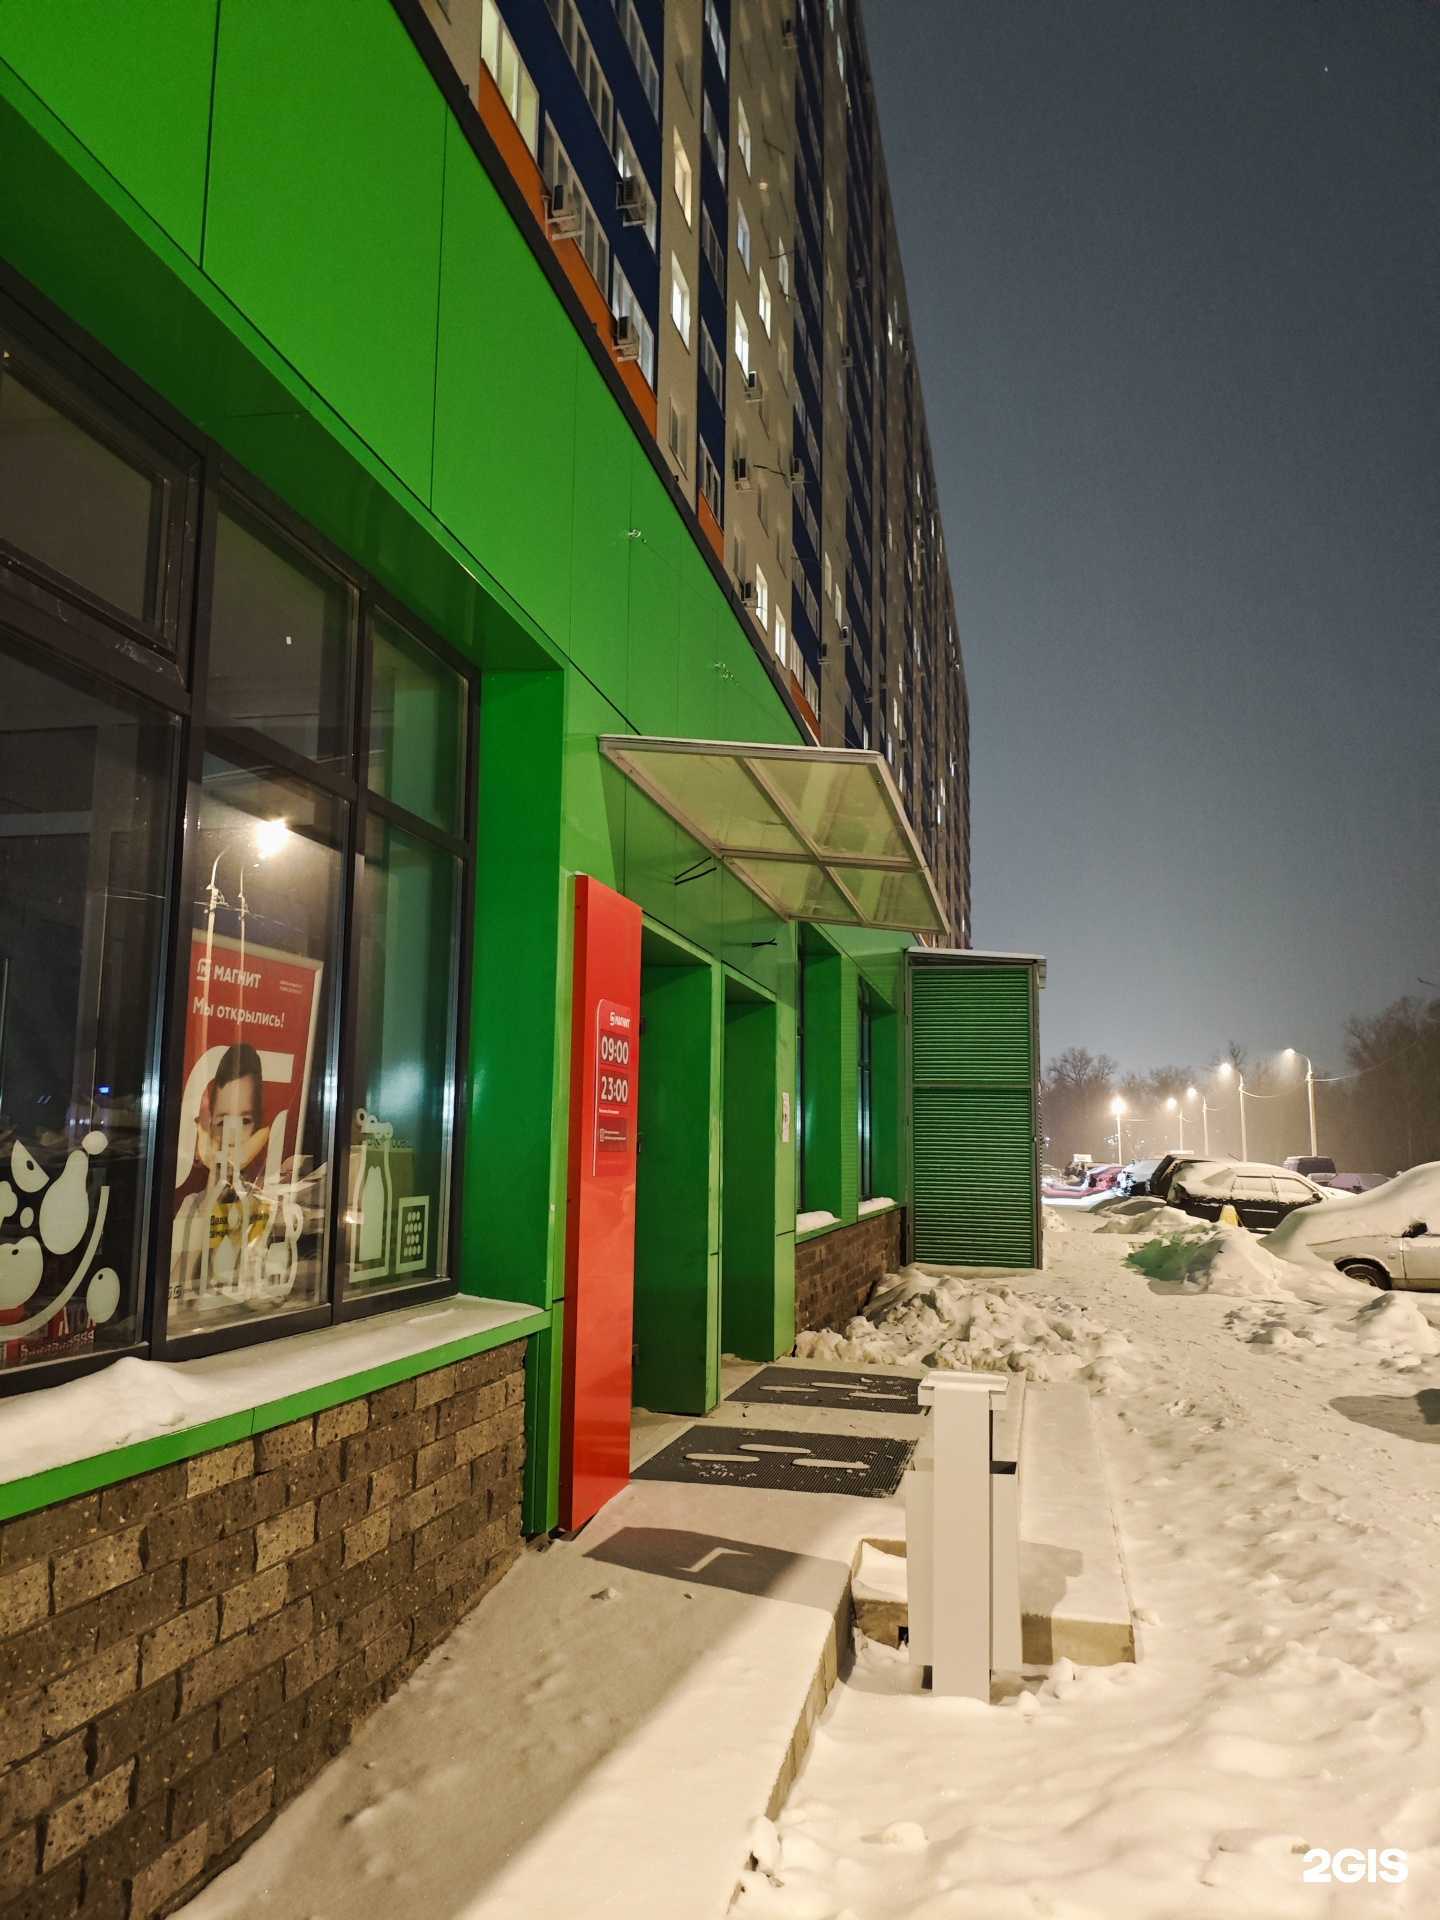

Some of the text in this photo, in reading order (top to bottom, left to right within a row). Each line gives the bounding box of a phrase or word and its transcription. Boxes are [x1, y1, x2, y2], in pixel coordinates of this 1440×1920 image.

[214, 964, 262, 989] МАГНИТ
[192, 996, 286, 1029] Мы открылись!
[601, 1036, 629, 1065] 09:00
[601, 1076, 628, 1103] 23:00
